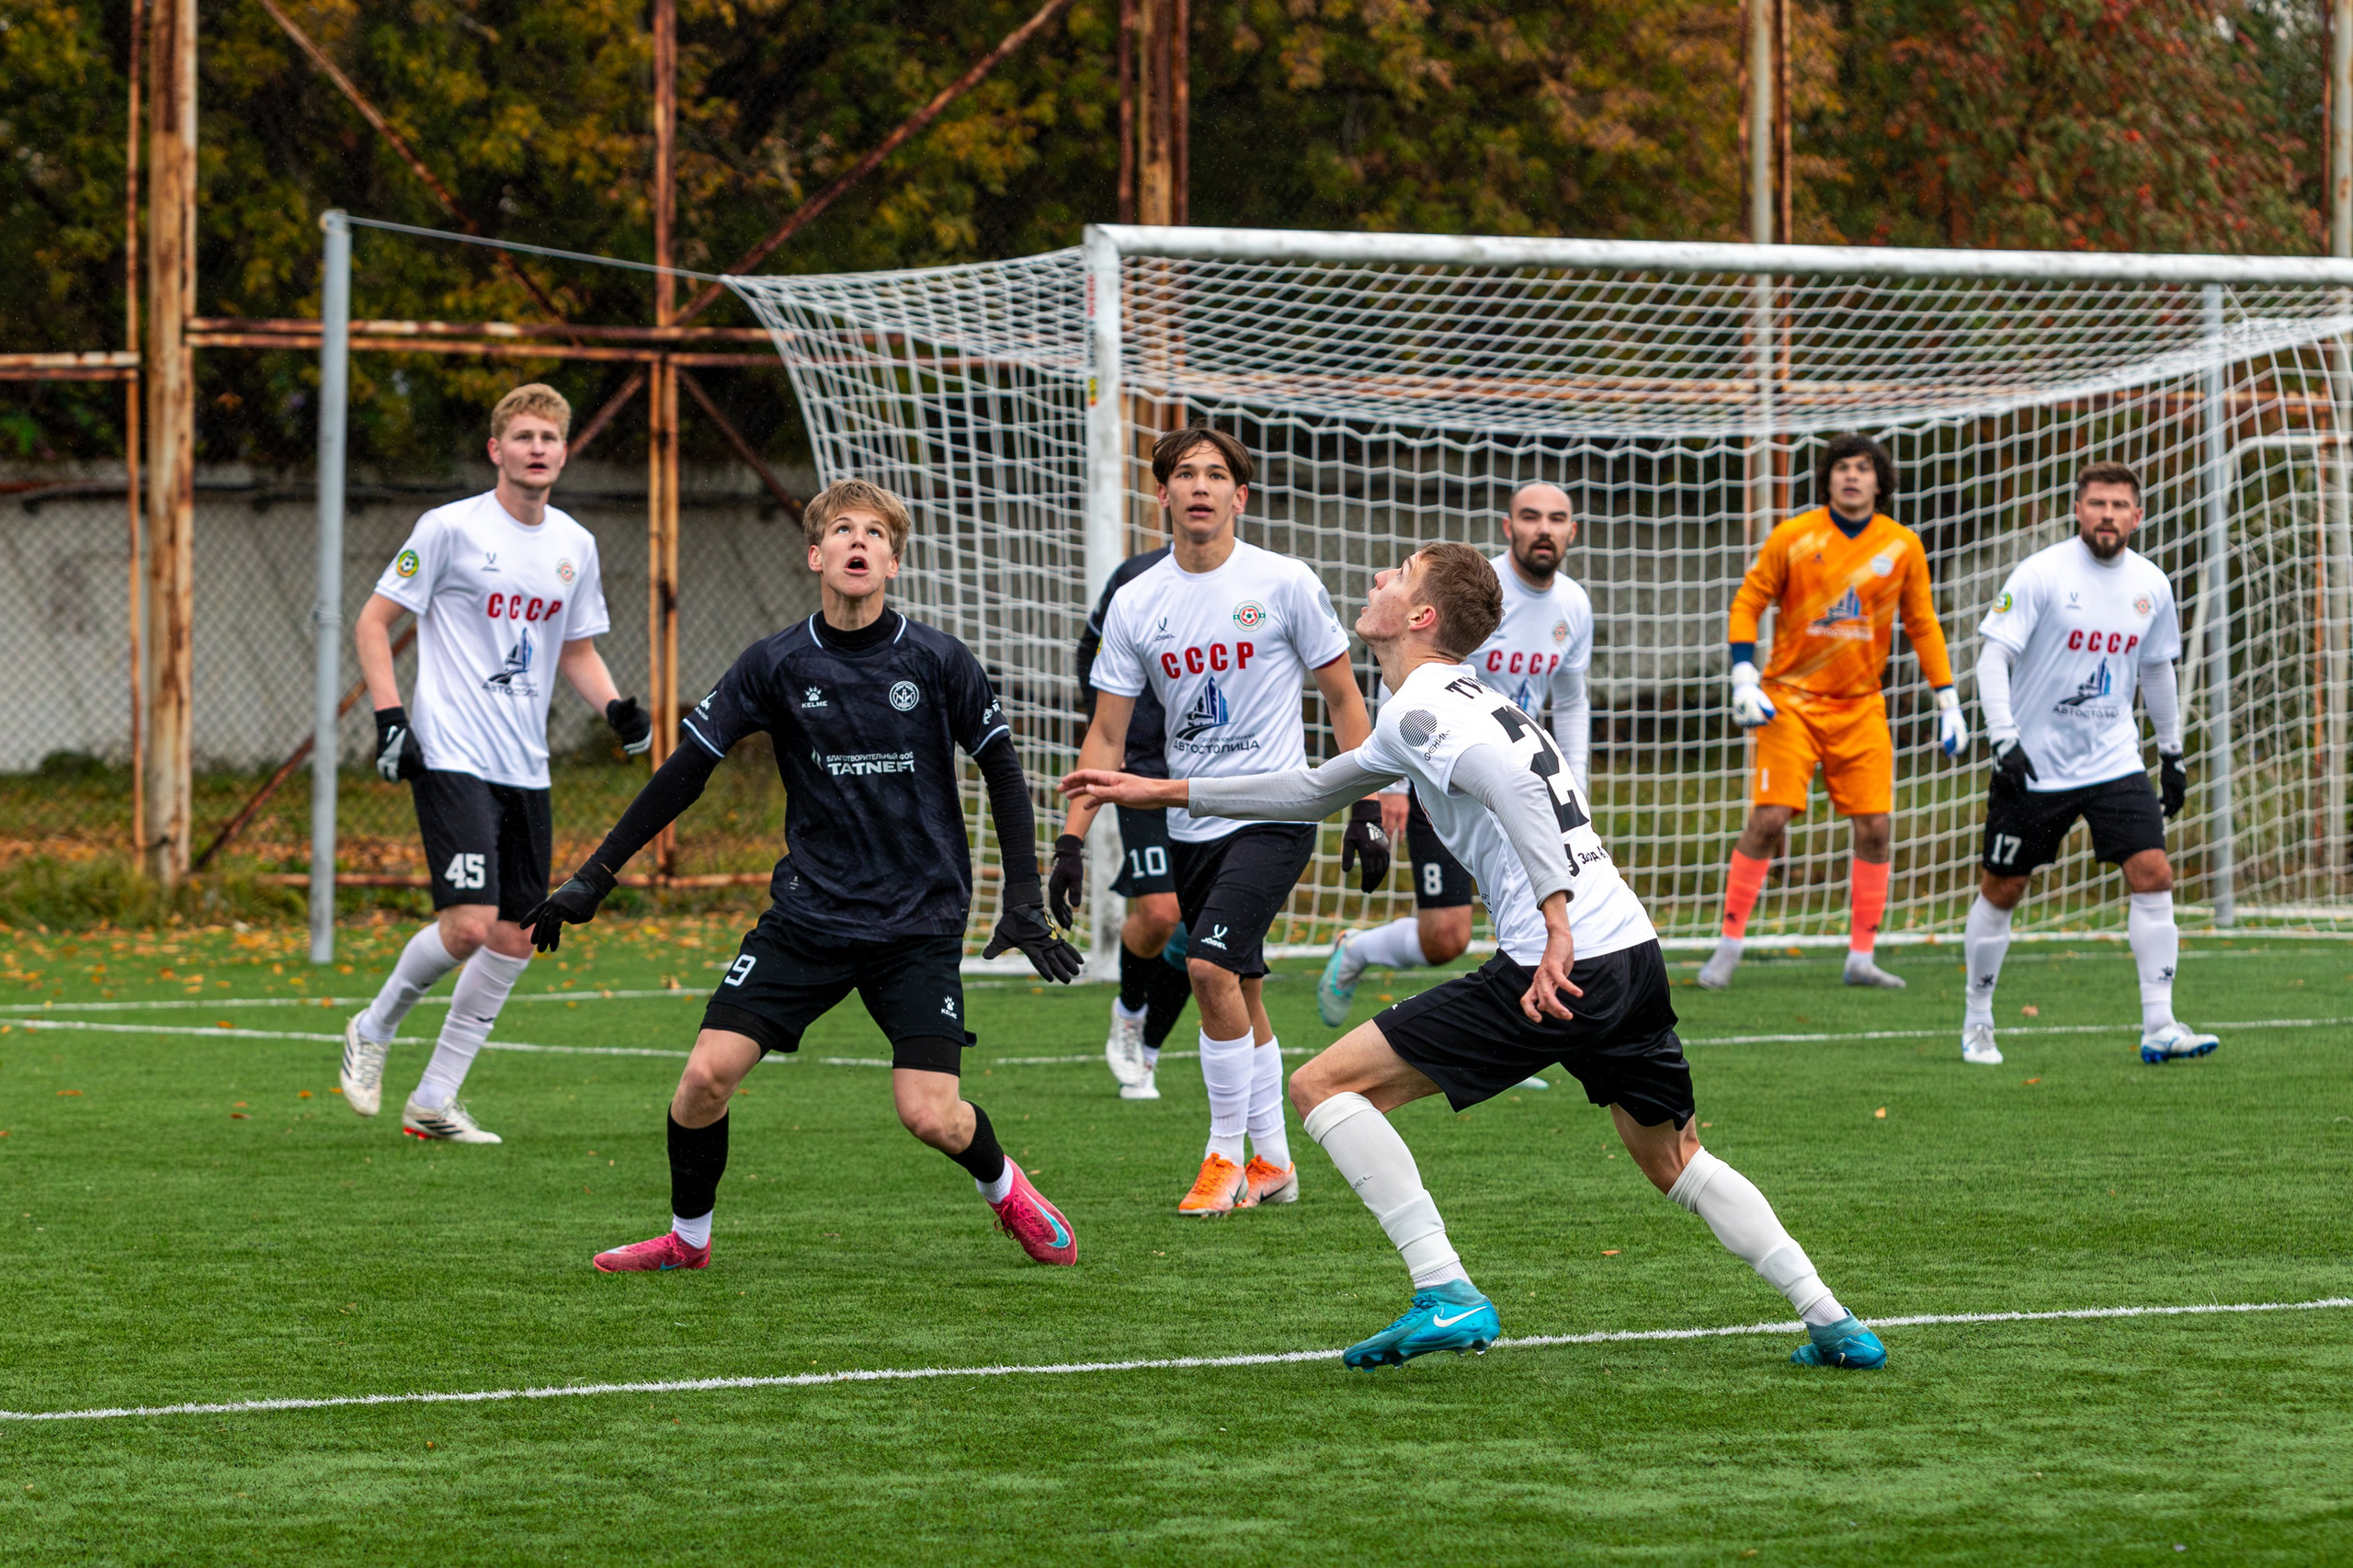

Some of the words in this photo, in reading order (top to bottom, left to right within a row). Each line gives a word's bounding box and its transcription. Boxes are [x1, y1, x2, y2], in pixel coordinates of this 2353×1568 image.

[486, 592, 563, 621] СССР
[2068, 629, 2139, 654] СССР
[1161, 642, 1254, 679] СССР
[1486, 650, 1560, 676] СССР
[801, 700, 828, 709] KELME
[826, 753, 898, 763] БЛАГОТВОРИТЕЛЬНЫЙ
[1173, 740, 1261, 754] АВТОСТОЛИЦА
[827, 760, 915, 776] TATNEFT
[1760, 767, 1769, 793] 1
[1129, 846, 1167, 879] 10
[1991, 833, 2022, 865] 17
[444, 853, 485, 889] 45
[1423, 862, 1442, 895] 8
[724, 954, 756, 986] 9
